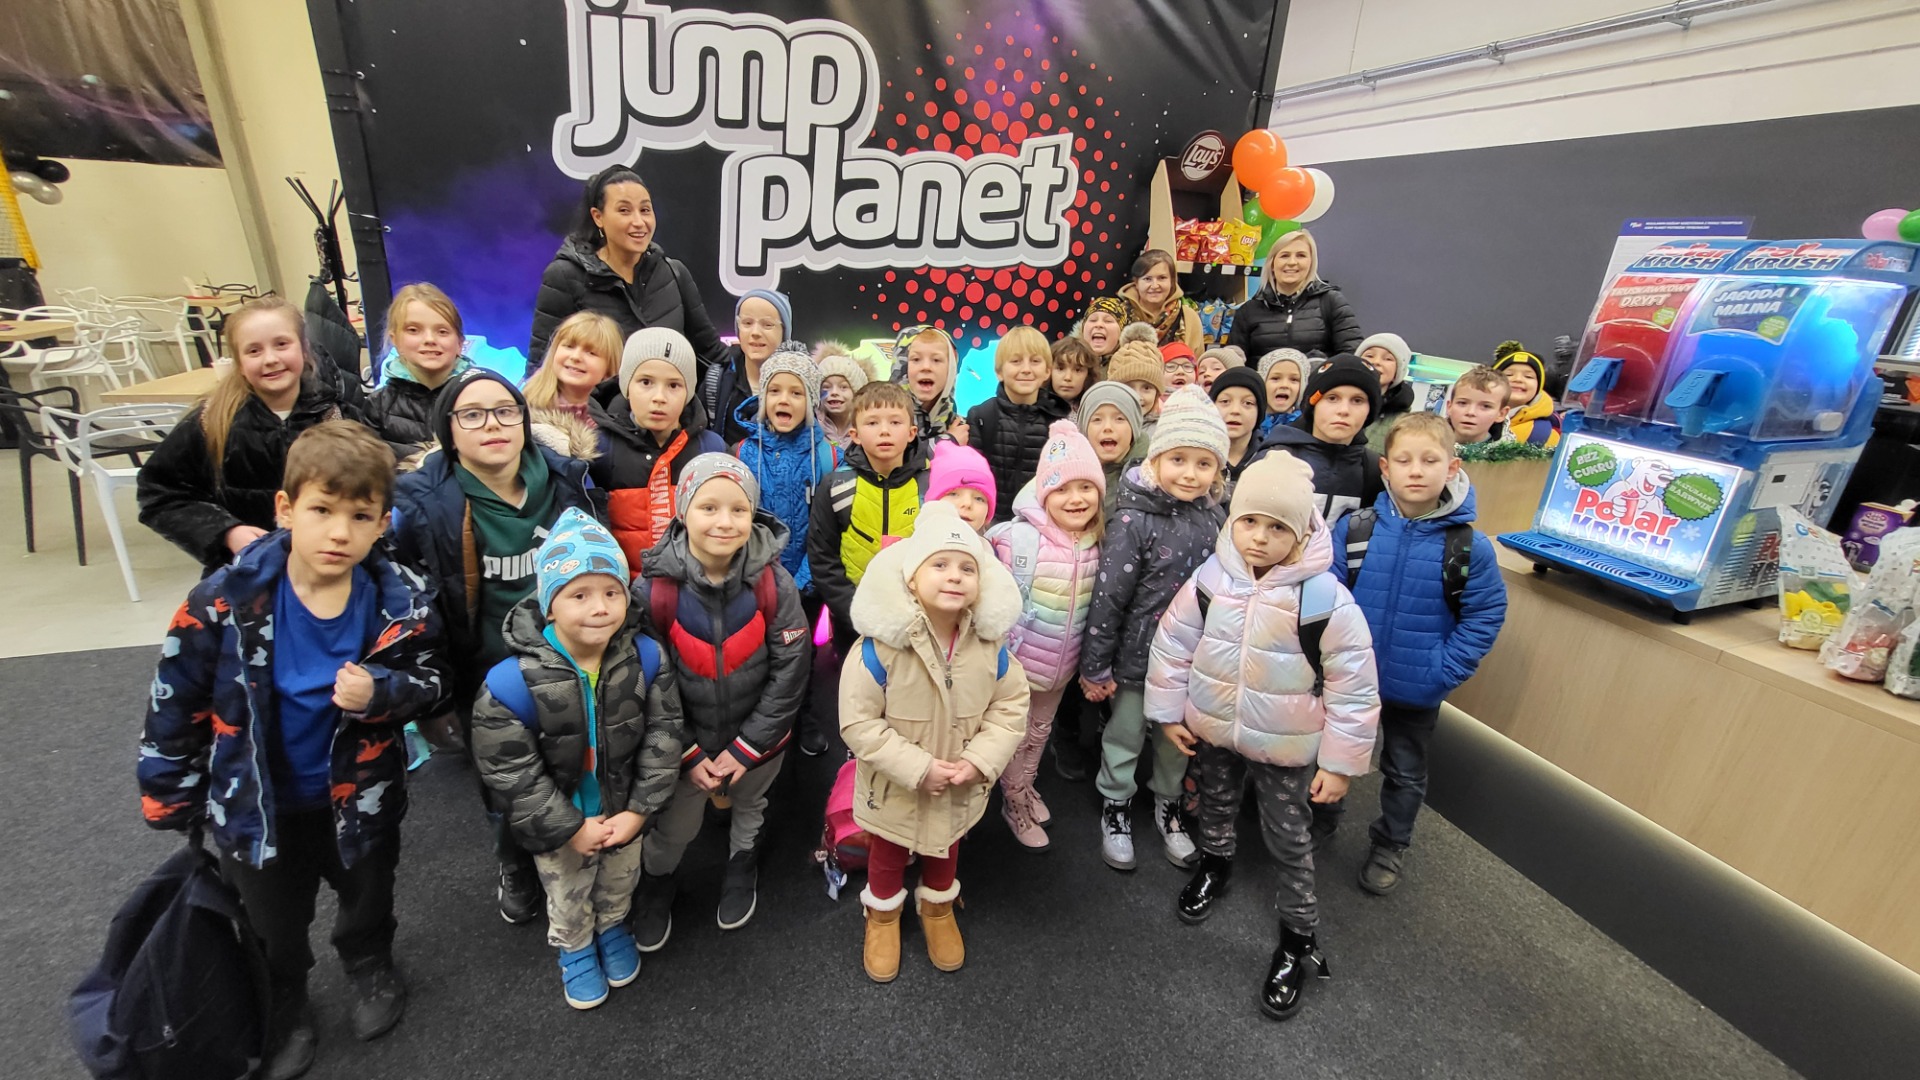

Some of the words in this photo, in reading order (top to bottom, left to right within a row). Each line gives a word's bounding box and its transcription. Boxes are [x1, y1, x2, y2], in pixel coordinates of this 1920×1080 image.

[572, 0, 866, 156] jump
[736, 126, 1066, 268] planet
[1633, 255, 1724, 270] KRUSH
[1734, 256, 1843, 271] KRUSH
[1610, 283, 1695, 297] TRUSKAWKOWY
[1714, 287, 1786, 303] JAGODA
[1789, 287, 1800, 298] I
[1619, 293, 1671, 308] DRYFT
[1714, 301, 1781, 317] MALINA
[1576, 451, 1600, 466] BEZ
[1573, 460, 1615, 479] CUKRU
[1575, 487, 1682, 536] Polar
[1568, 513, 1673, 561] KRUSH
[483, 547, 538, 581] PUM
